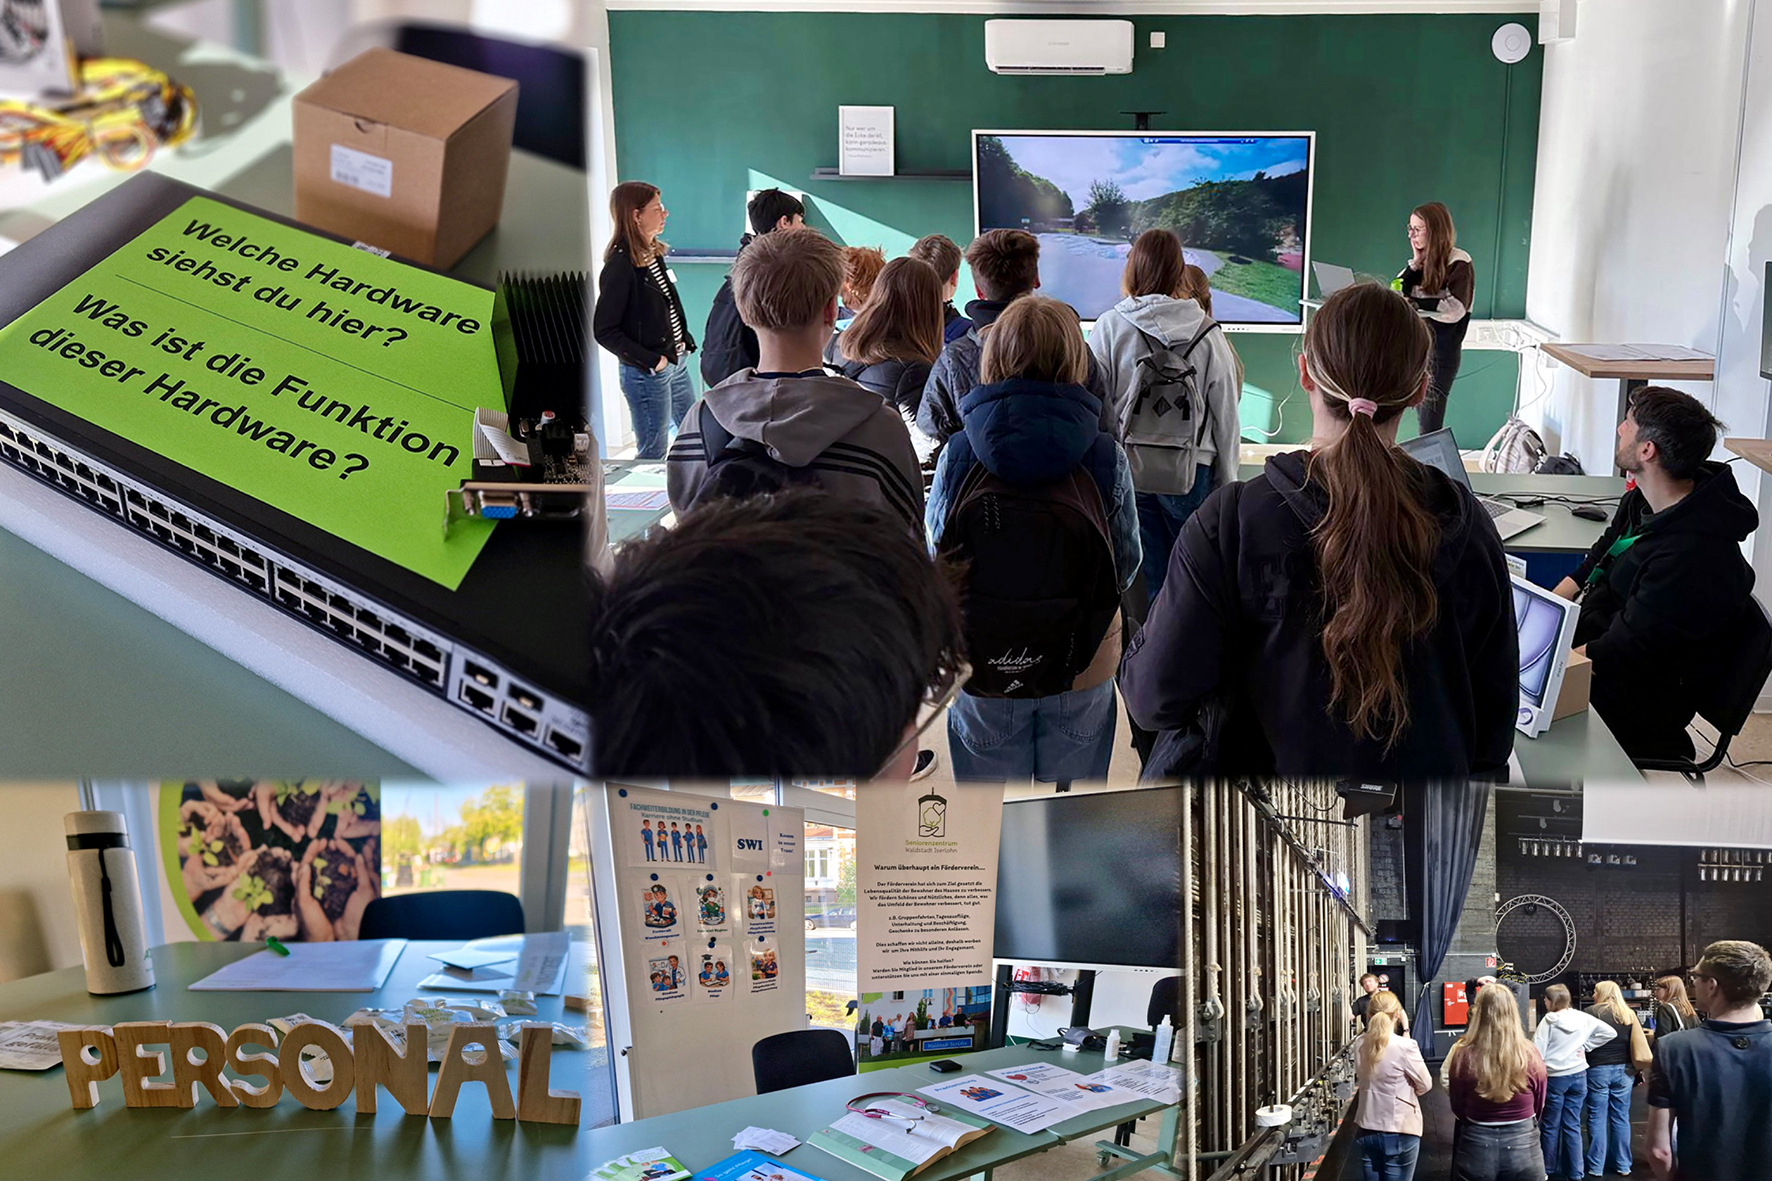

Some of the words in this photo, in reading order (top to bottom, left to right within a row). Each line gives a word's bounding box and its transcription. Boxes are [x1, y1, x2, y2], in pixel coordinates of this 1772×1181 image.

[147, 246, 252, 292] siehst
[254, 284, 300, 312] du
[306, 302, 408, 348] hier?
[182, 218, 300, 273] Welche
[305, 262, 482, 336] Hardware
[29, 325, 144, 384] dieser
[143, 374, 370, 481] Hardware?
[73, 294, 148, 339] Was
[151, 327, 207, 361] ist
[206, 347, 265, 387] die
[272, 374, 460, 467] Funktion
[988, 647, 1043, 665] adidas
[630, 803, 681, 814] FACHWEITERBILDUNG
[696, 810, 710, 818] PFLEGE
[737, 838, 763, 850] SWI
[57, 1020, 582, 1125] PERSONAL
